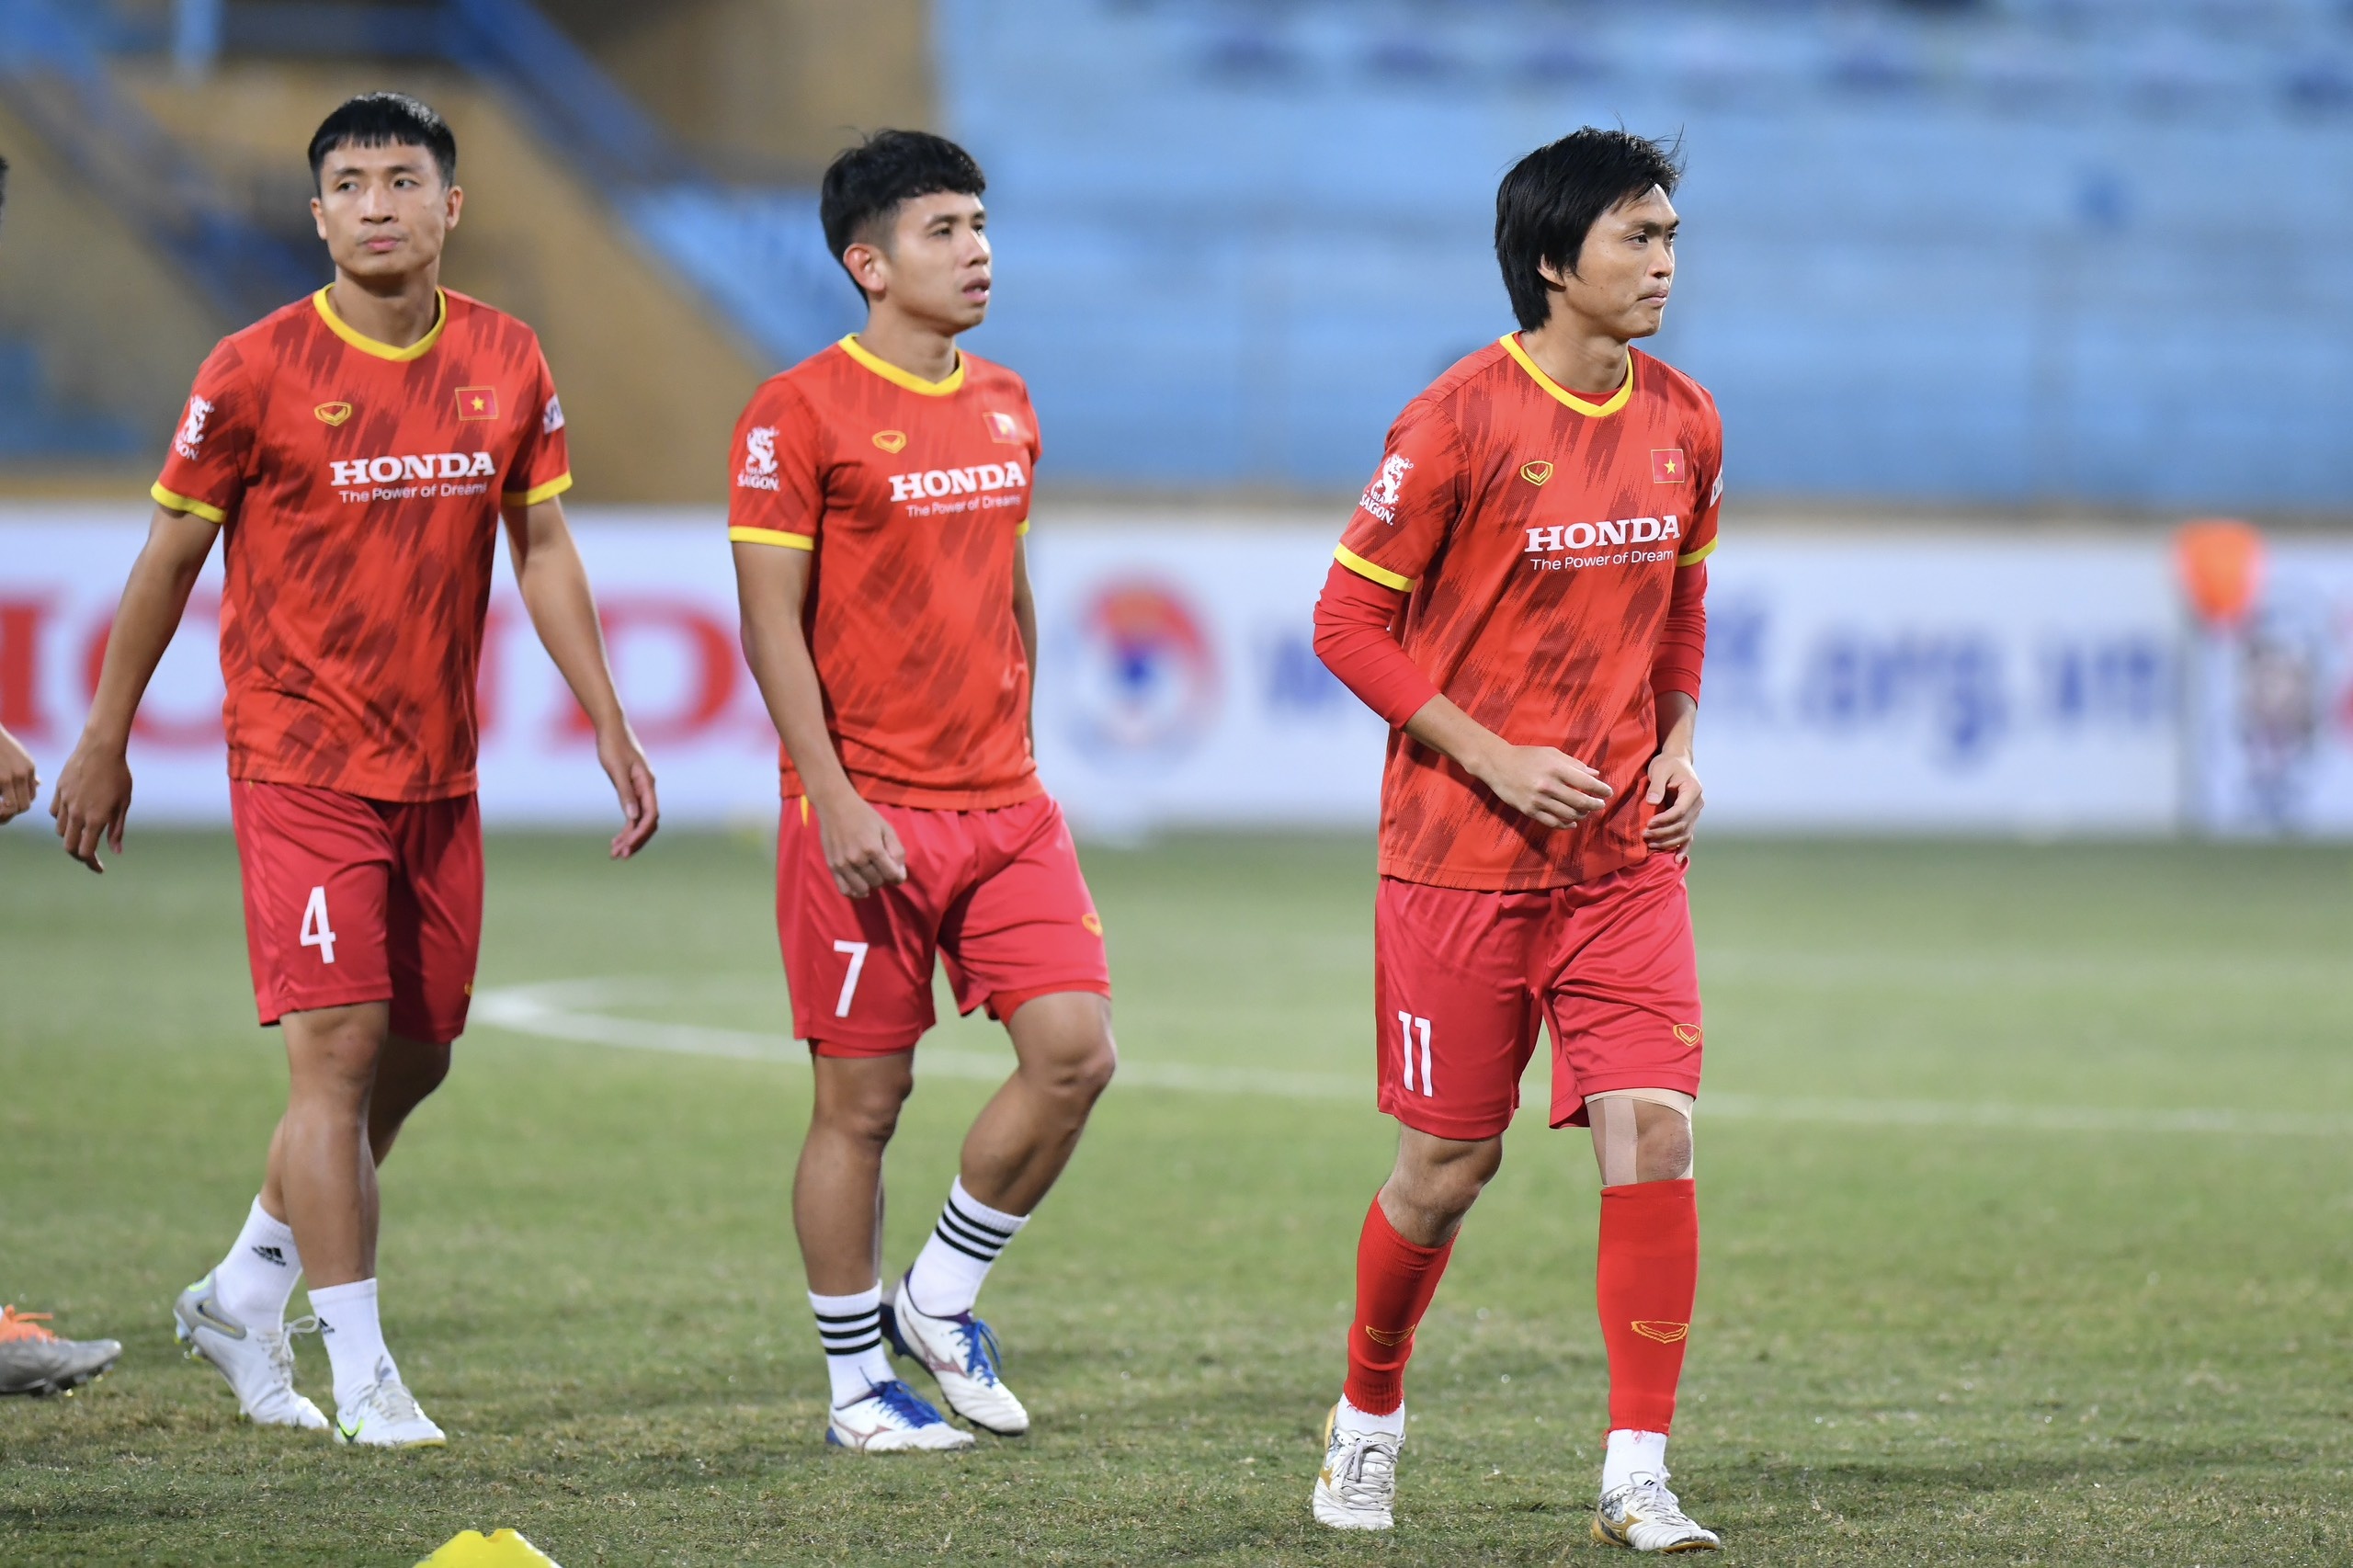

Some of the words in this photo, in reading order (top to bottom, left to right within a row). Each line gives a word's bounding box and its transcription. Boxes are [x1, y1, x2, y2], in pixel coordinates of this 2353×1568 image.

[329, 451, 496, 486] HONDA
[888, 460, 1027, 502] HONDA
[338, 490, 369, 504] The
[372, 486, 418, 501] Power
[420, 483, 438, 498] of
[906, 504, 931, 517] The
[932, 501, 965, 516] Power
[967, 497, 981, 511] of
[1524, 514, 1681, 552] HONDA
[1529, 558, 1563, 571] The
[1564, 554, 1609, 569] Power
[1612, 551, 1629, 564] of
[1631, 549, 1675, 563] Dream
[299, 886, 336, 964] 4
[834, 940, 869, 1017] 7
[1397, 1010, 1433, 1097] 11
